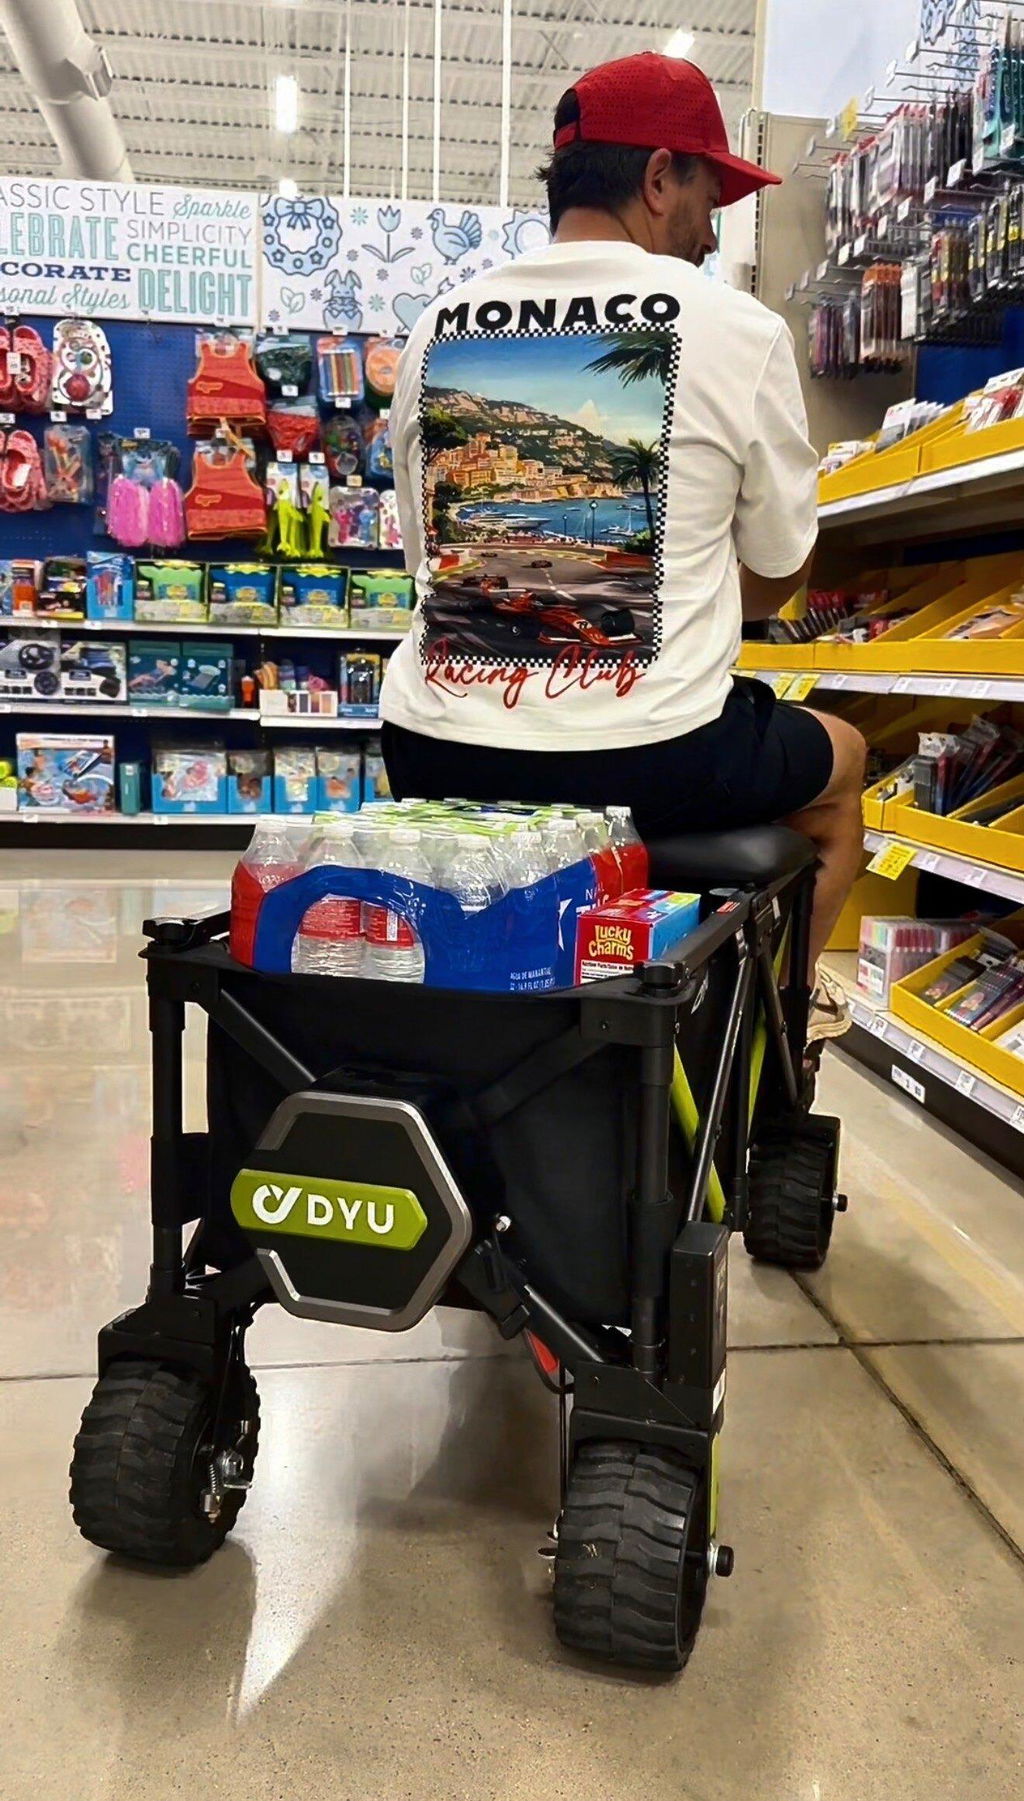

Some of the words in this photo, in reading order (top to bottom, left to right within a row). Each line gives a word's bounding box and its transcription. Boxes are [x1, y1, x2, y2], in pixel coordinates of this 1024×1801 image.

[80, 187, 164, 216] STYLE
[173, 193, 252, 220] Sparkle
[0, 212, 119, 261] EBRATE
[127, 219, 252, 245] SIMPLICITY
[127, 243, 252, 269] CHEERFUL
[0, 261, 131, 282] CORATE
[62, 283, 130, 314] Styles
[138, 268, 252, 317] DELIGHT
[434, 293, 681, 337] MONACO
[425, 636, 539, 709] Racing
[545, 645, 645, 699] Club
[594, 924, 632, 946] Lucky
[588, 940, 635, 961] Charms
[307, 1193, 395, 1234] DYU
